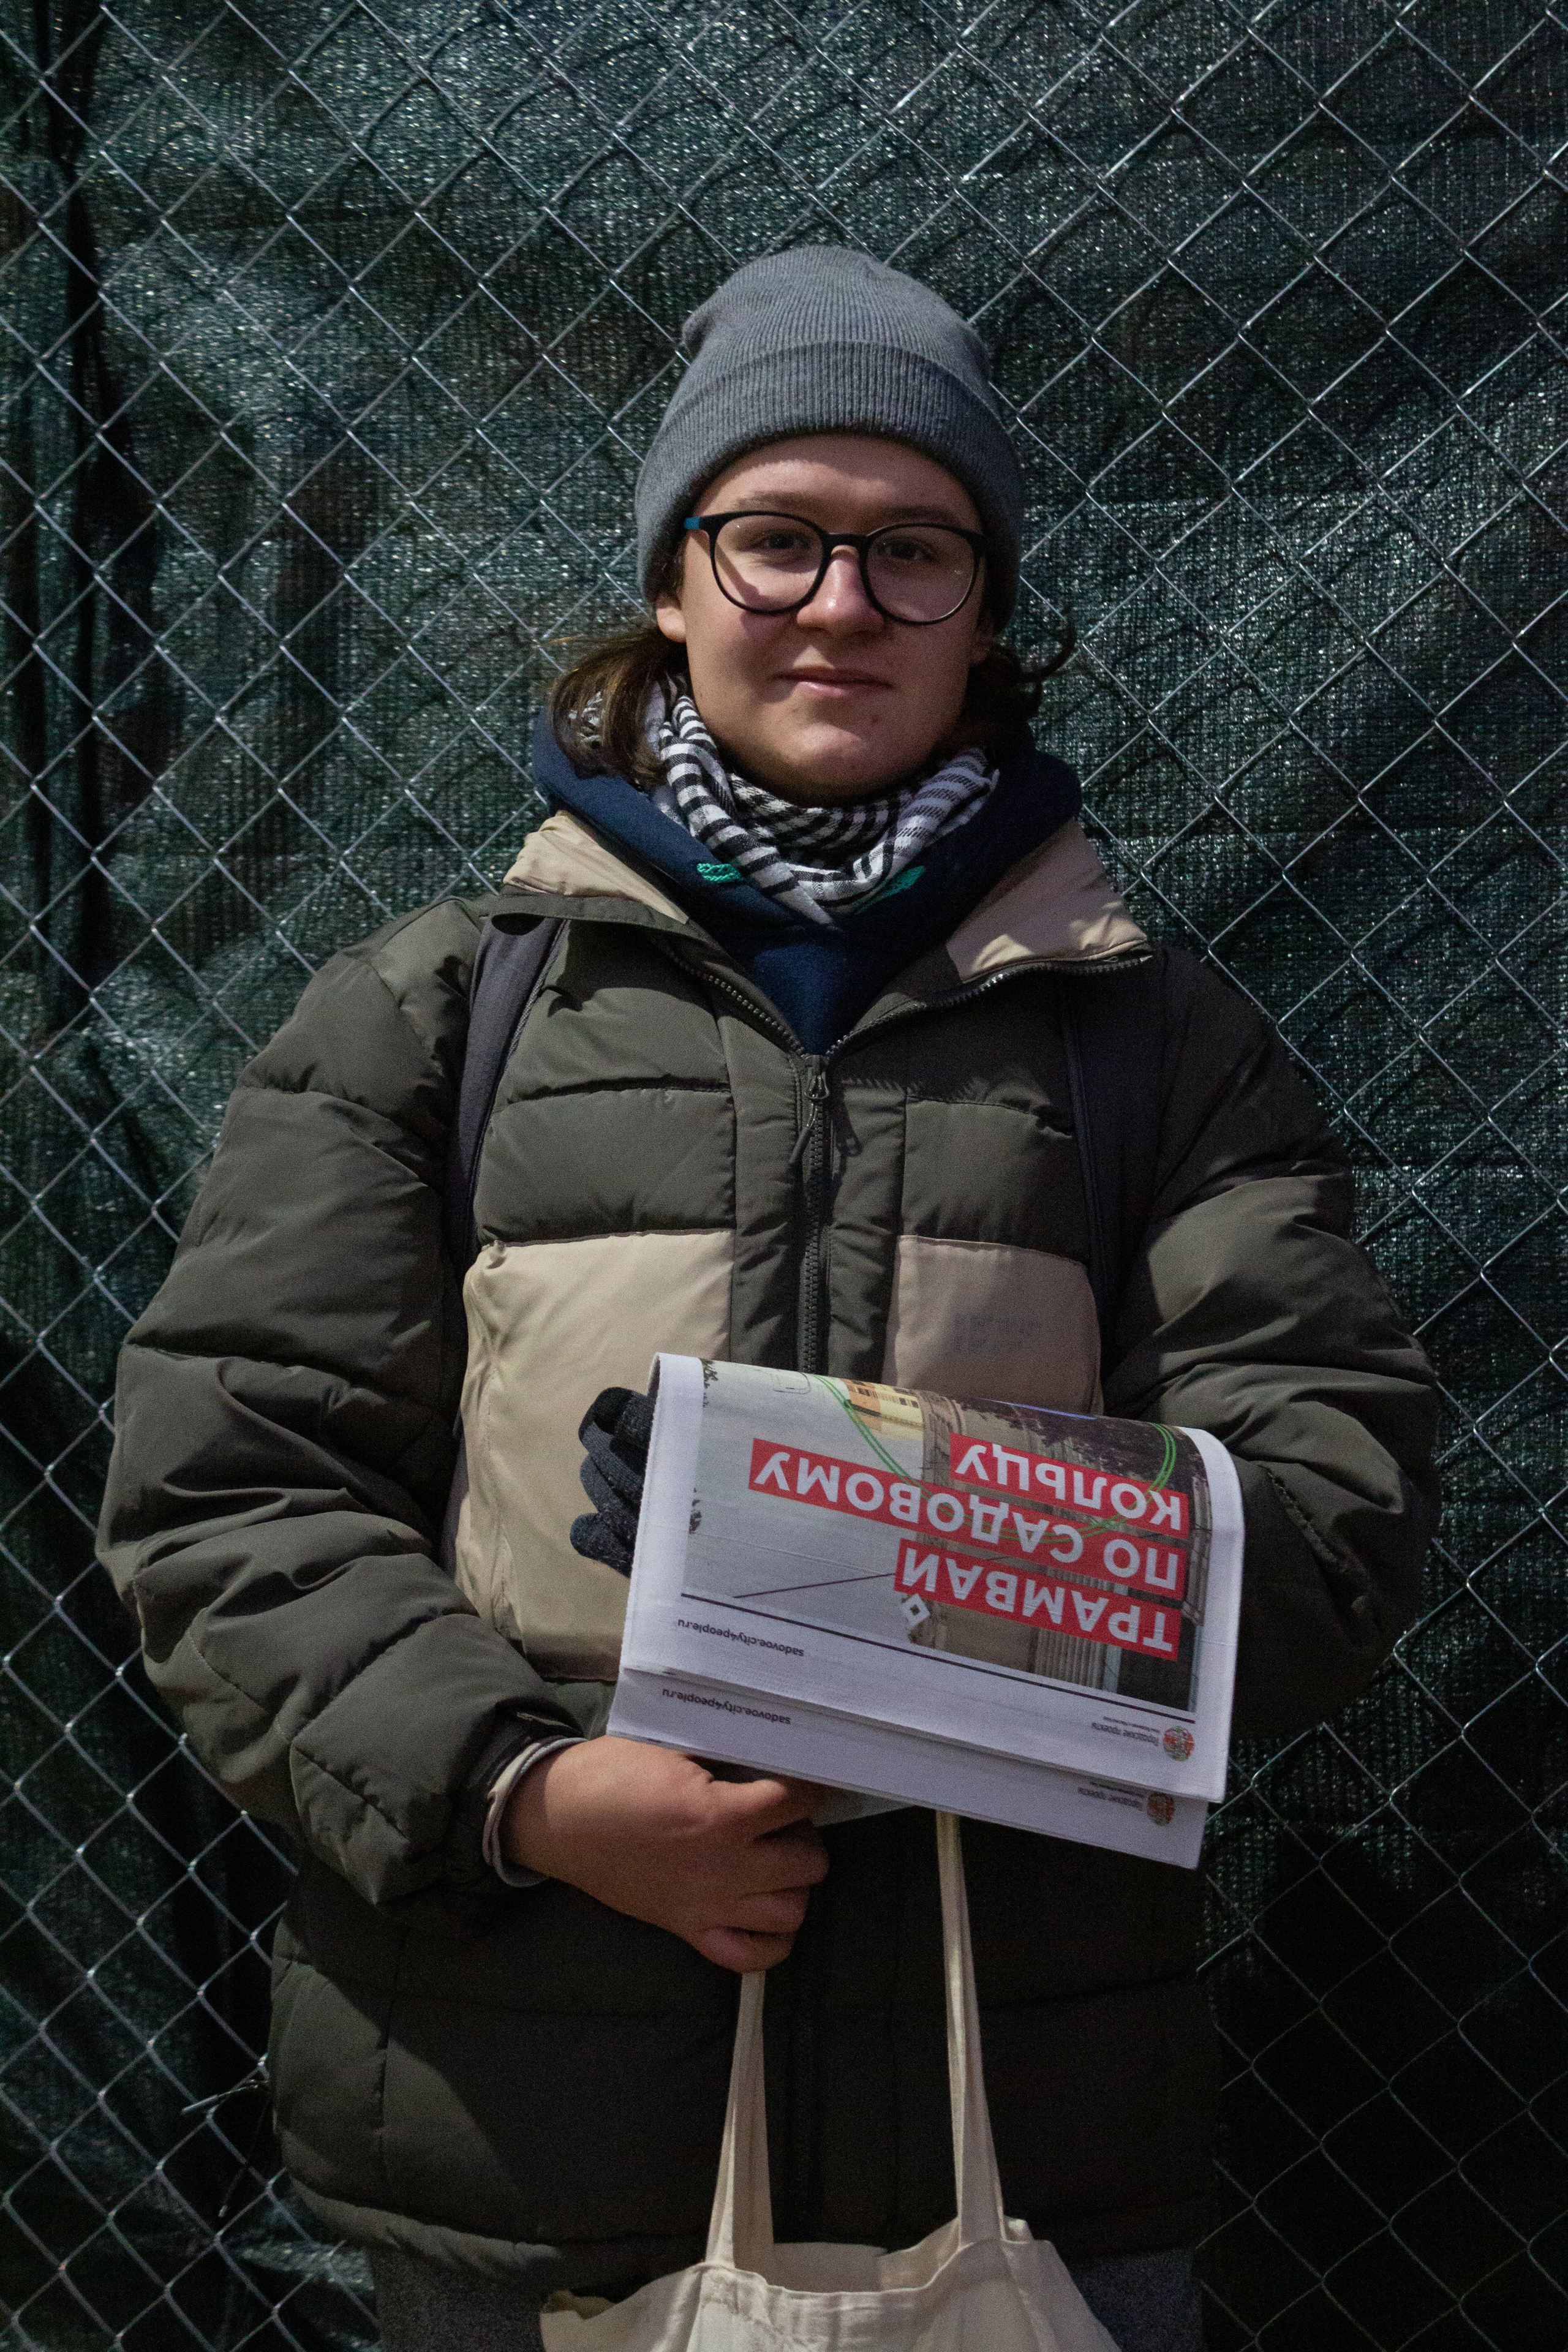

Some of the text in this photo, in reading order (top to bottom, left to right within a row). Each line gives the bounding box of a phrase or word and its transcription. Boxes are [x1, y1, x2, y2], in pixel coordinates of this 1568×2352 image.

[955, 1443, 1181, 1531] КОЛЬЦУ
[754, 1452, 1178, 1591] ПО САДОВОМУ
[677, 1619, 805, 1657] sadovoe.city4people.ru
[662, 1688, 791, 1725] sadovoe.city4people.ru
